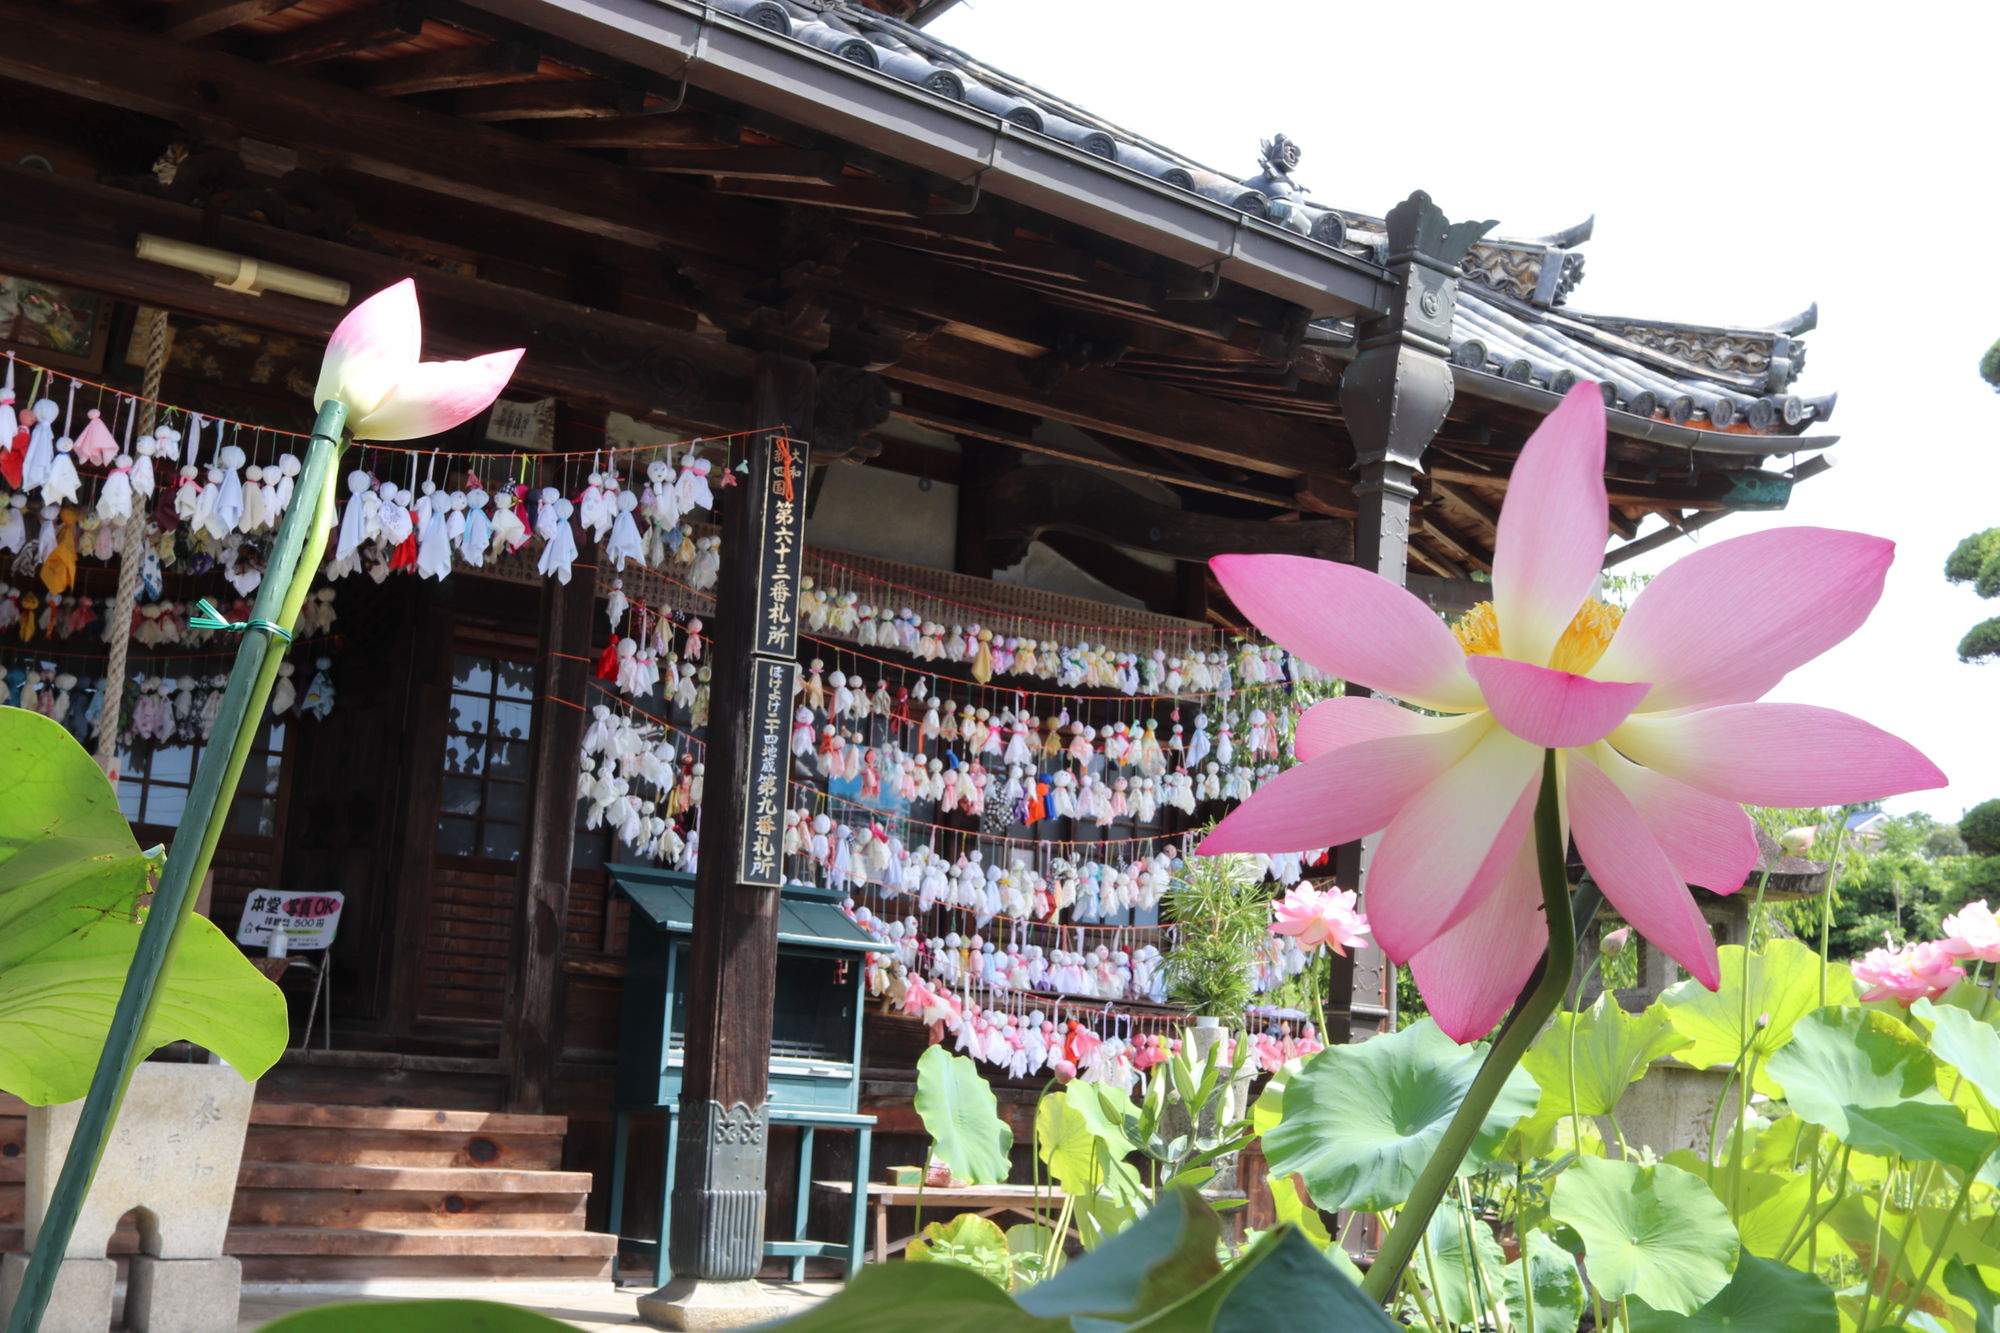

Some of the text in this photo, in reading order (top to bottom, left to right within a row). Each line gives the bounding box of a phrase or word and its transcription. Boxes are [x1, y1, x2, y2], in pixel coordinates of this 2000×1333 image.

[766, 500, 795, 650] 第六十三番札所
[251, 894, 281, 914] 本堂
